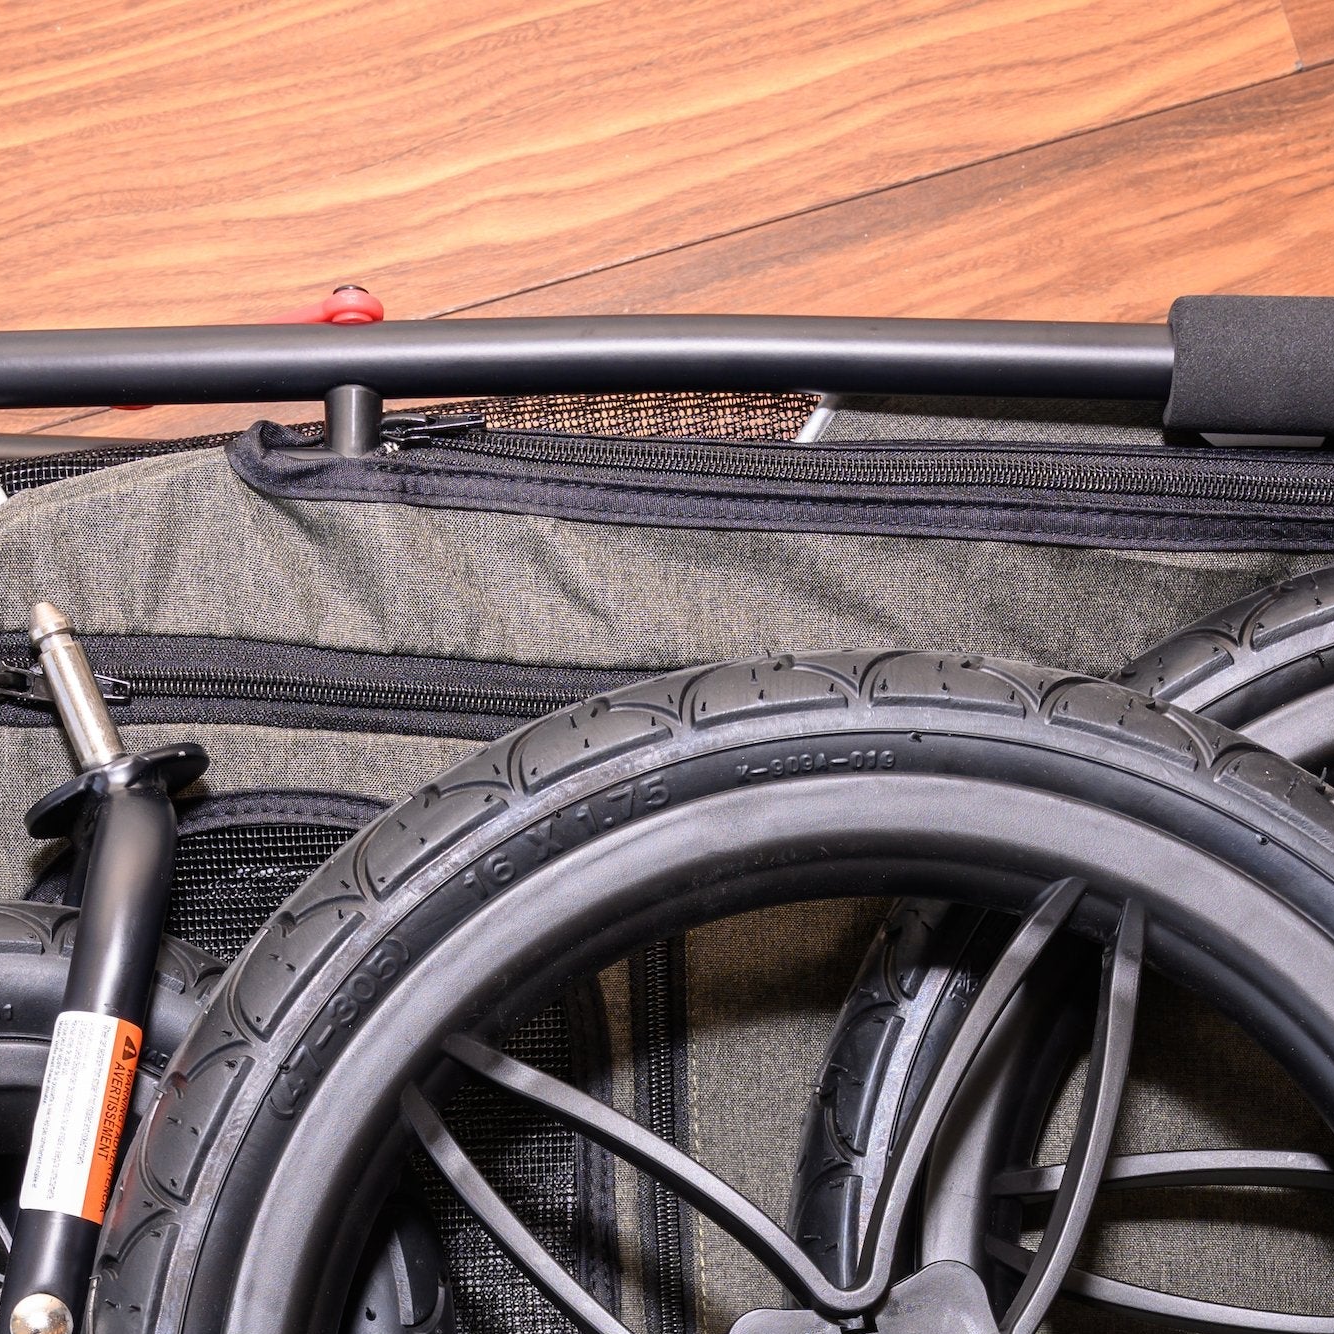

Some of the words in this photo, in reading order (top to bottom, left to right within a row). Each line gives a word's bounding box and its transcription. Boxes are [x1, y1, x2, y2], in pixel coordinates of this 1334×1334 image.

[462, 853, 516, 902] 16
[575, 776, 670, 839] 1.75
[97, 1060, 121, 1160] AVERTISSEMENT
